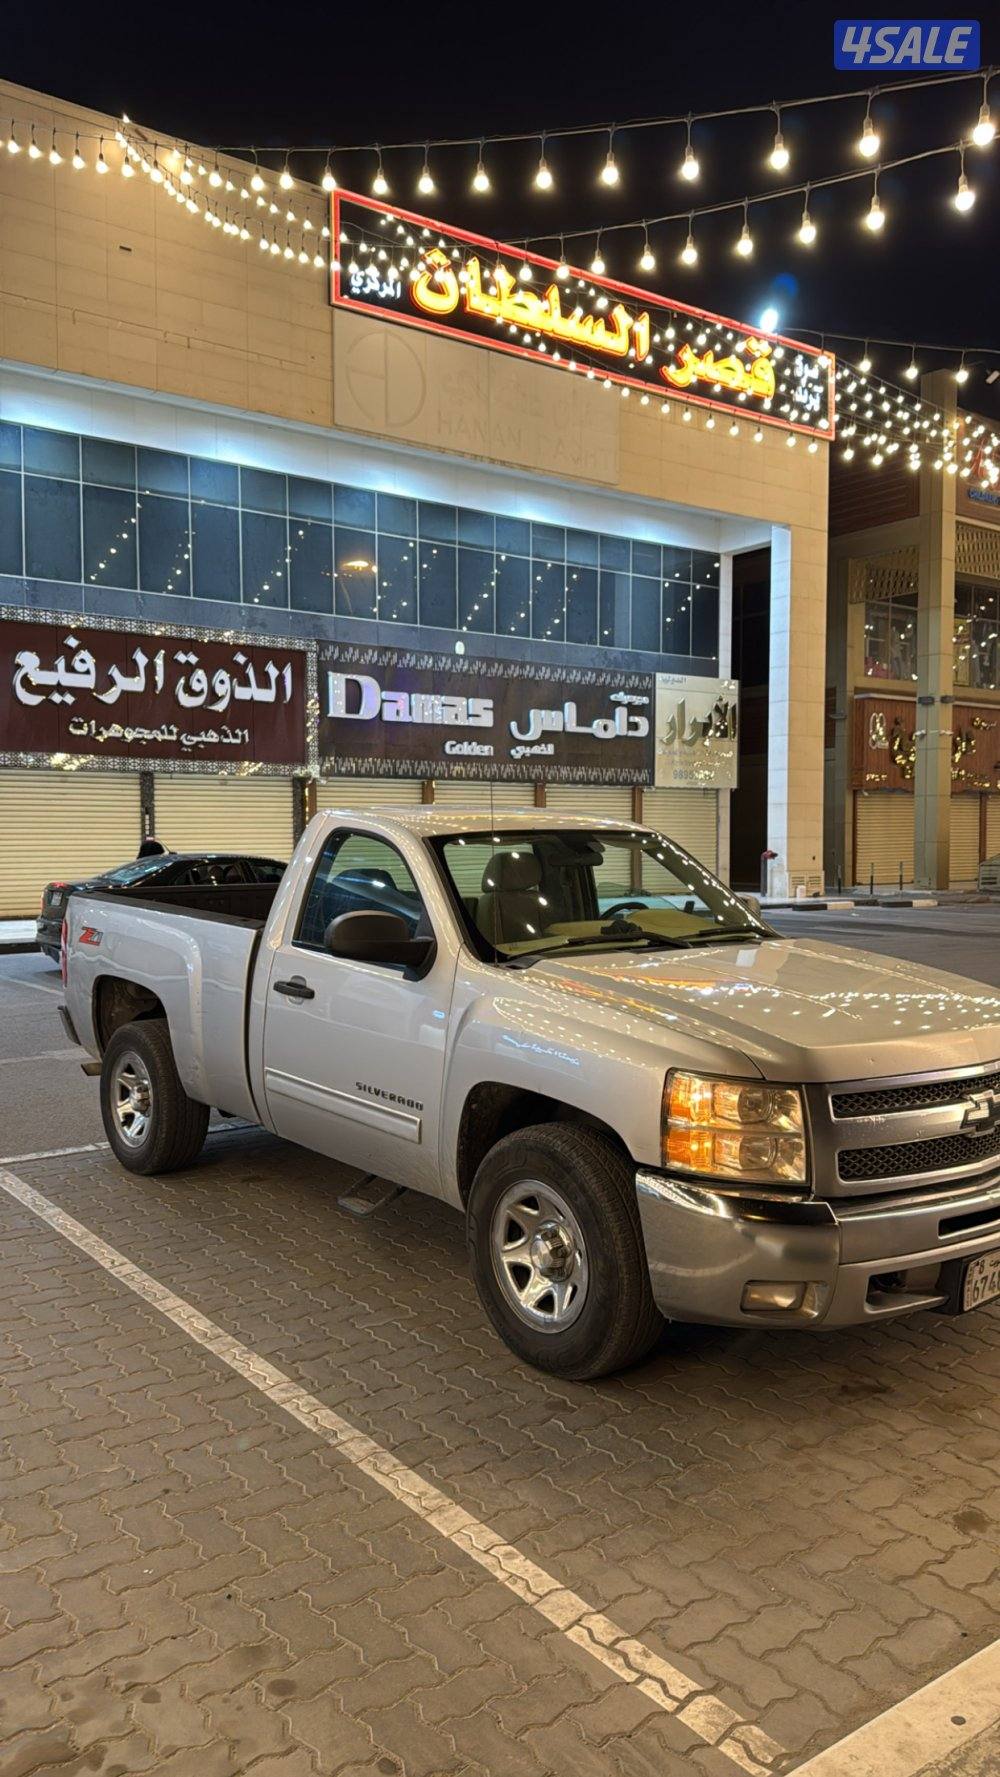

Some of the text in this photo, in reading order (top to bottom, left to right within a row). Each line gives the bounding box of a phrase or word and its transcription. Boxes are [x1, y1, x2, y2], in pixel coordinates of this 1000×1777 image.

[410, 248, 650, 361] السلطان
[660, 336, 775, 400] قصر
[13, 634, 292, 712] الذوق الرفيع
[327, 671, 494, 728] Damas
[510, 702, 649, 741] داماس
[68, 716, 249, 751] الذهبي للمجوهرات
[444, 740, 494, 757] Golden
[355, 1081, 424, 1112] SILVERADO
